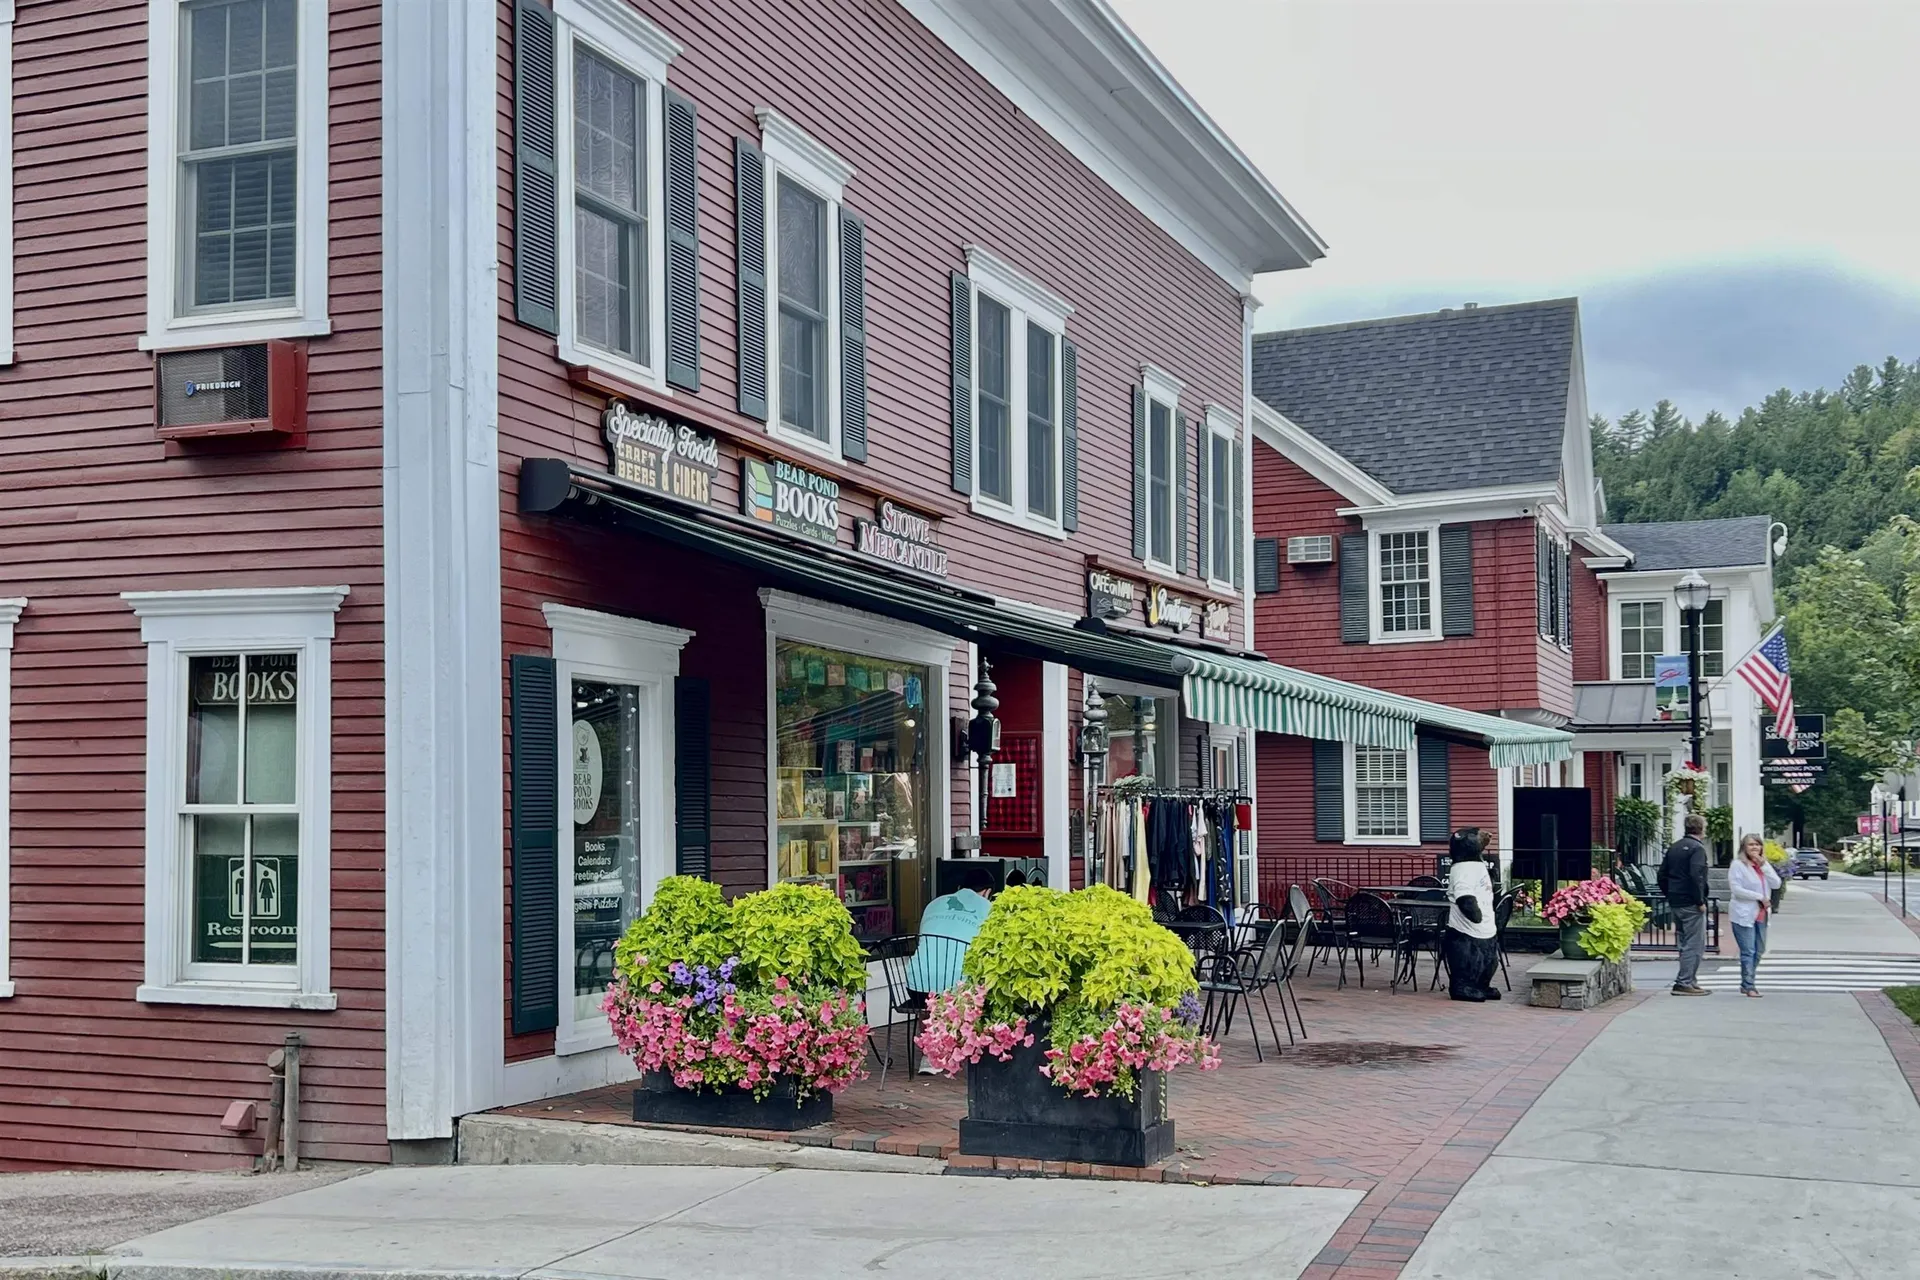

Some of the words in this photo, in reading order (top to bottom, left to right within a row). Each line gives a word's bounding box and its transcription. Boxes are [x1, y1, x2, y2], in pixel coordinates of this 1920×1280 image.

[196, 381, 241, 391] FRIEDRICH
[610, 403, 675, 463] Specialty
[676, 425, 719, 468] Foods
[618, 442, 657, 467] CRAFT
[618, 459, 657, 488] BEERS
[661, 462, 669, 492] &
[673, 462, 709, 504] CIDERS
[775, 460, 807, 488] BEAR
[808, 473, 840, 499] POND
[775, 481, 839, 530] BOOKS
[775, 514, 798, 531] Puzzles
[801, 522, 818, 538] Cards
[821, 529, 836, 544] Wrap
[882, 501, 930, 545] STOWE
[860, 521, 948, 577] MERCANTILE
[212, 671, 297, 700] BOOKS
[573, 773, 592, 786] BEAR
[573, 786, 592, 798] POND
[584, 841, 606, 852] Books
[578, 855, 612, 867] Calendars
[575, 870, 599, 882] reeting
[574, 901, 592, 913] gsaw
[207, 922, 297, 936] Resroom
